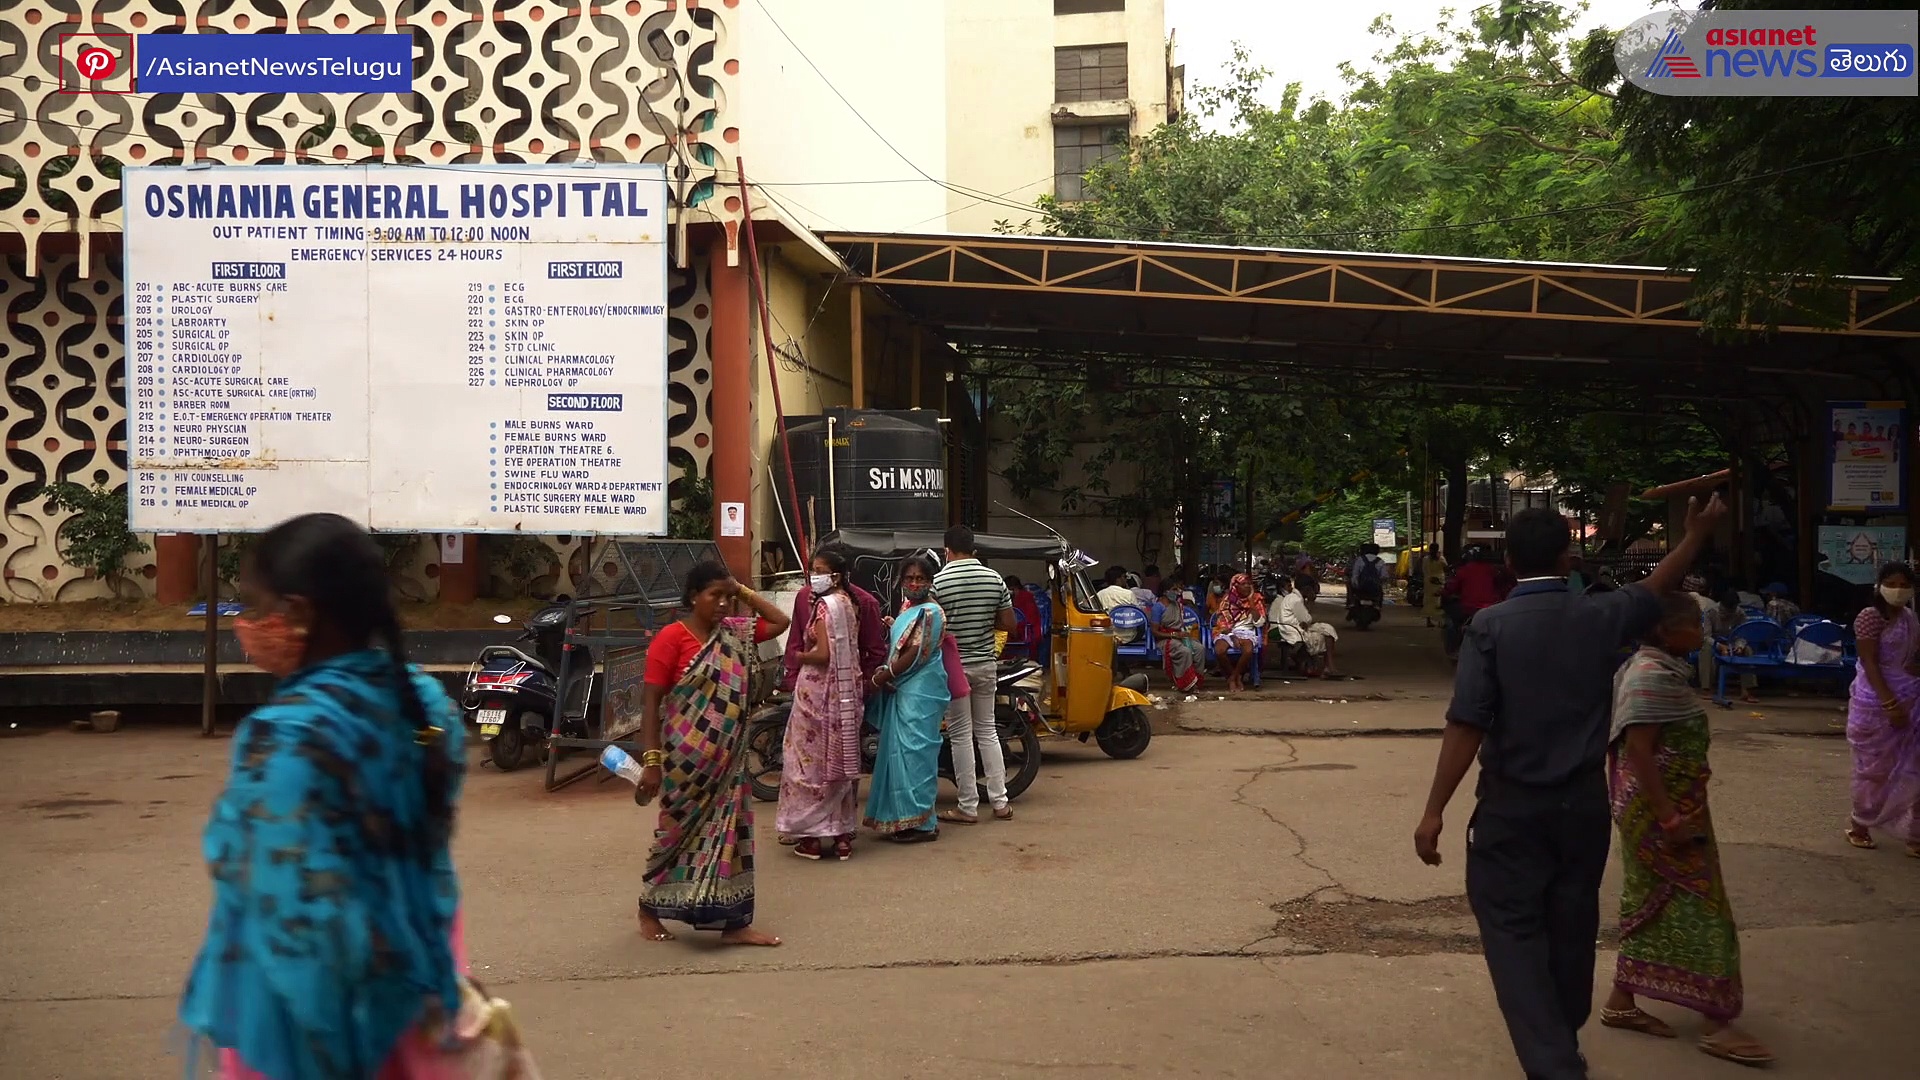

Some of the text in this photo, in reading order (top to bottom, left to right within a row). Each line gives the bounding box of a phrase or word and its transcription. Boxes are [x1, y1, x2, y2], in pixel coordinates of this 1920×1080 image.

[145, 182, 648, 219] OSMANIA GENERAL HOSPITAL
[213, 226, 243, 238] OUT
[248, 227, 308, 239] PATIENT
[405, 226, 425, 240] AM
[430, 226, 446, 240] TO
[491, 227, 530, 240] NOON
[292, 249, 503, 261] EMERGENCY SERVICES 24 HOURS
[215, 264, 281, 277] FIRST FLOOR
[551, 263, 620, 277] FIRST FLOOR
[136, 283, 288, 291] 201 ABC-ACUTE BURNS CARE
[468, 283, 525, 291] 219 ECG
[136, 295, 152, 303] 202
[468, 295, 484, 303] 220
[136, 306, 213, 314] 203 UROLOGY
[468, 307, 483, 315] 221
[136, 318, 227, 326] 204 LABROARTY
[468, 319, 483, 327] 222
[136, 330, 230, 339] 205 SURGICAL OP
[468, 332, 544, 341] 223 SKIN OP
[136, 341, 229, 350] 206 SURGICAL OP
[504, 343, 524, 351] STD
[137, 353, 242, 363] 207 CARDIOLOGY OP
[468, 356, 616, 364] 225 CLINICAL PHARMACOLOGY
[137, 365, 153, 373] 208
[172, 366, 230, 374] CARDIOLOGY
[468, 368, 614, 376] 226 CLINICAL PHARMACOLOGY
[138, 377, 153, 385] 209
[172, 377, 222, 385] ASC-ACUTE
[468, 378, 485, 386] 227
[504, 379, 564, 387] NEPHROLOGY
[138, 389, 153, 397] 210
[173, 389, 223, 397] ASC-ACUTE
[139, 401, 153, 409] 211
[173, 401, 206, 409] BARBER
[549, 397, 620, 409] SECOND FLOOR
[138, 412, 154, 420] 212
[296, 413, 332, 421] THEATER
[138, 424, 154, 432] 213
[206, 425, 247, 433] PHYSCIAN
[531, 421, 561, 429] BURNS
[138, 436, 155, 444] 214
[209, 437, 249, 445] SURGEON
[504, 433, 607, 442] FEMALE BURNS WARD
[139, 448, 154, 456] 215
[173, 449, 238, 458] OPHTHMOLOGY
[504, 445, 555, 454] OPERATION
[560, 446, 603, 454] THEATRE
[504, 458, 621, 467] EYE OPERATION THEATRE
[139, 473, 244, 482] 216 HIV COUNSELLING
[504, 470, 536, 478] SWINE
[869, 467, 895, 490] Sri
[140, 485, 257, 496] 217 FEMALE MEDICAL OP
[504, 482, 572, 490] ENDOCRINOLOGY
[575, 482, 599, 490] WARD
[609, 483, 662, 491] DEPARTMENT
[504, 493, 635, 503] PLASTIC SURGERY MALE WARD
[140, 498, 156, 506] 218
[201, 500, 236, 508] MEDICAL
[504, 505, 647, 514] PLASTIC SURGERY FEMALE WARD
